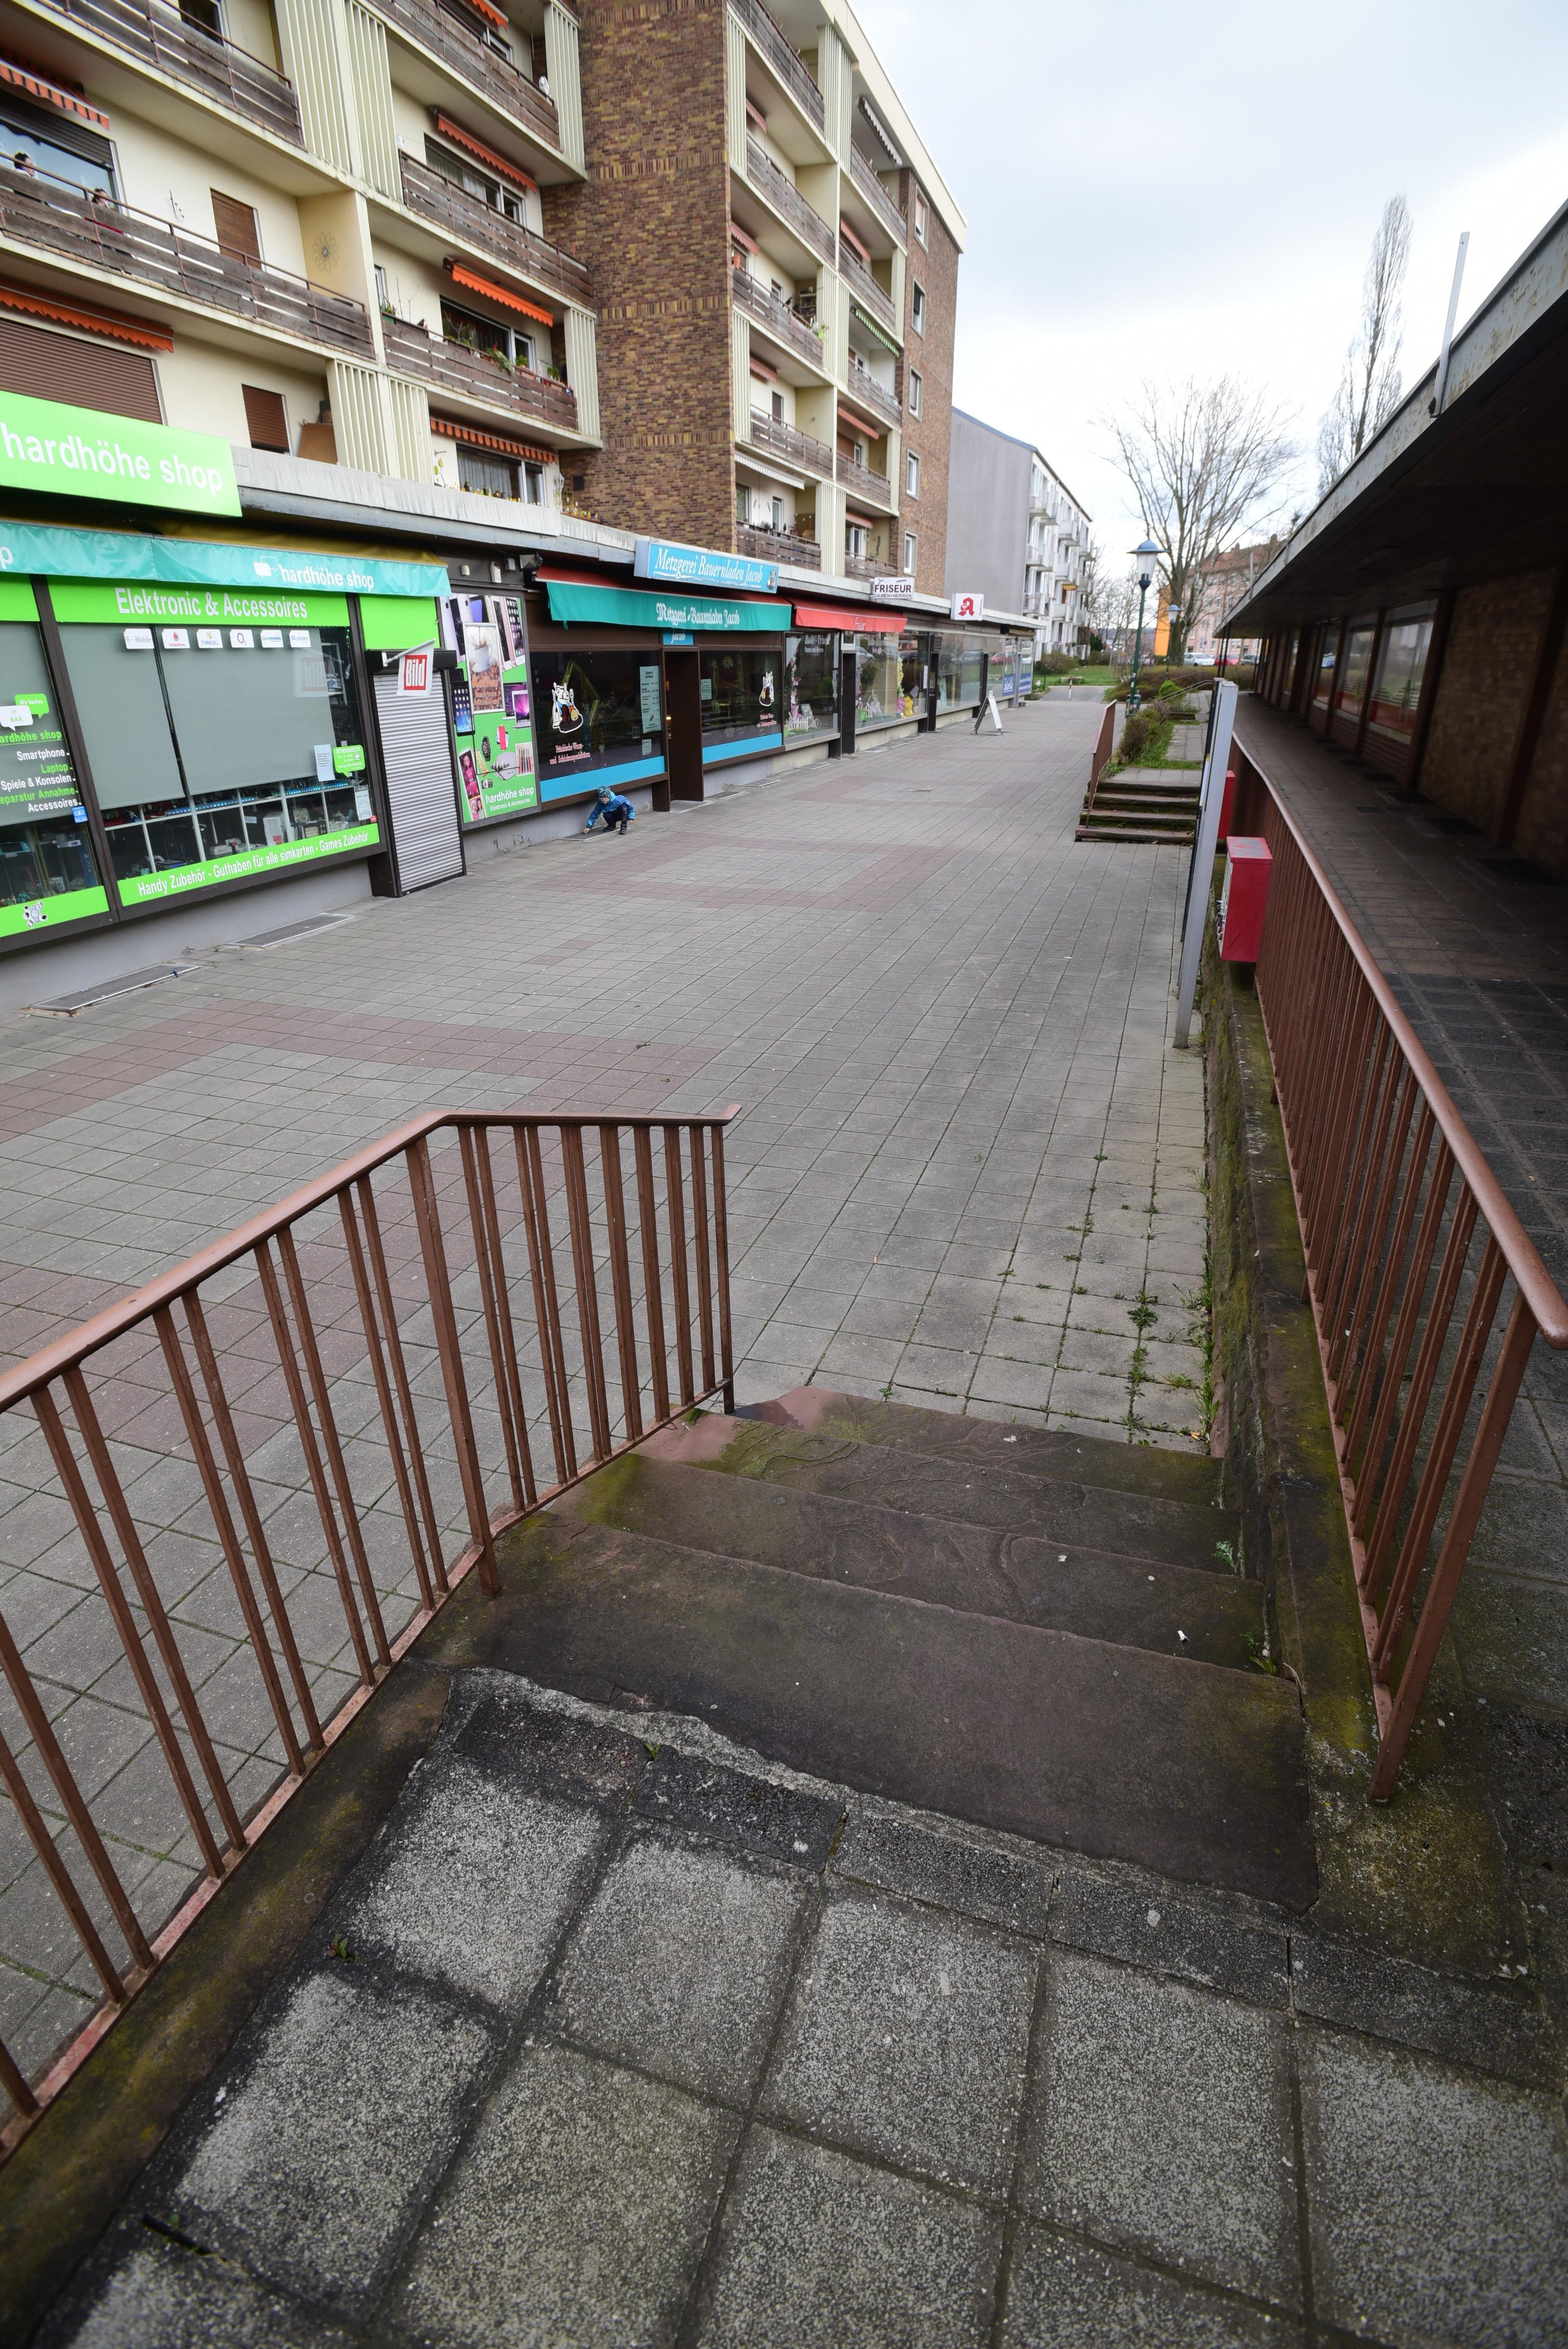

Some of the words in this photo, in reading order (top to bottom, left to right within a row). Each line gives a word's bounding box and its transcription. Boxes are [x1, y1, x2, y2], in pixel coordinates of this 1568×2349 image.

[0, 422, 151, 480] hardhöhe
[160, 454, 223, 498] shop
[654, 548, 698, 579] Metzgerei
[698, 555, 744, 581] Bauernladen
[744, 563, 763, 585] Jacob
[279, 564, 344, 586] hardhöhe
[346, 569, 374, 589] shop
[875, 584, 912, 593] FRISEUR
[115, 588, 201, 616] Elektronic
[206, 592, 219, 616] &
[224, 593, 308, 618] Accessoires
[656, 602, 687, 626] Metzgerei
[724, 609, 740, 628] Jacob
[671, 631, 686, 644] Jacob
[40, 729, 62, 740] shop
[17, 749, 66, 761] Smartphone
[41, 763, 68, 774] Laptop
[1, 778, 27, 792] Spiele
[28, 777, 35, 787] &
[35, 774, 72, 786] Konsolen
[0, 792, 35, 805] eparatur
[39, 787, 75, 799] Annahme
[486, 790, 517, 804] hardhöhe
[519, 787, 534, 797] shop
[28, 798, 78, 813] Accessoires
[490, 803, 508, 812] Elektronic
[511, 798, 531, 806] Accessoires
[138, 881, 168, 896] Handy
[169, 870, 206, 889] Zubehör
[213, 860, 252, 878] Guthaben
[252, 855, 264, 868] für
[265, 851, 279, 864] alle
[280, 844, 314, 862] simkarten
[319, 838, 342, 852] Games
[343, 831, 369, 847] Zubehör
